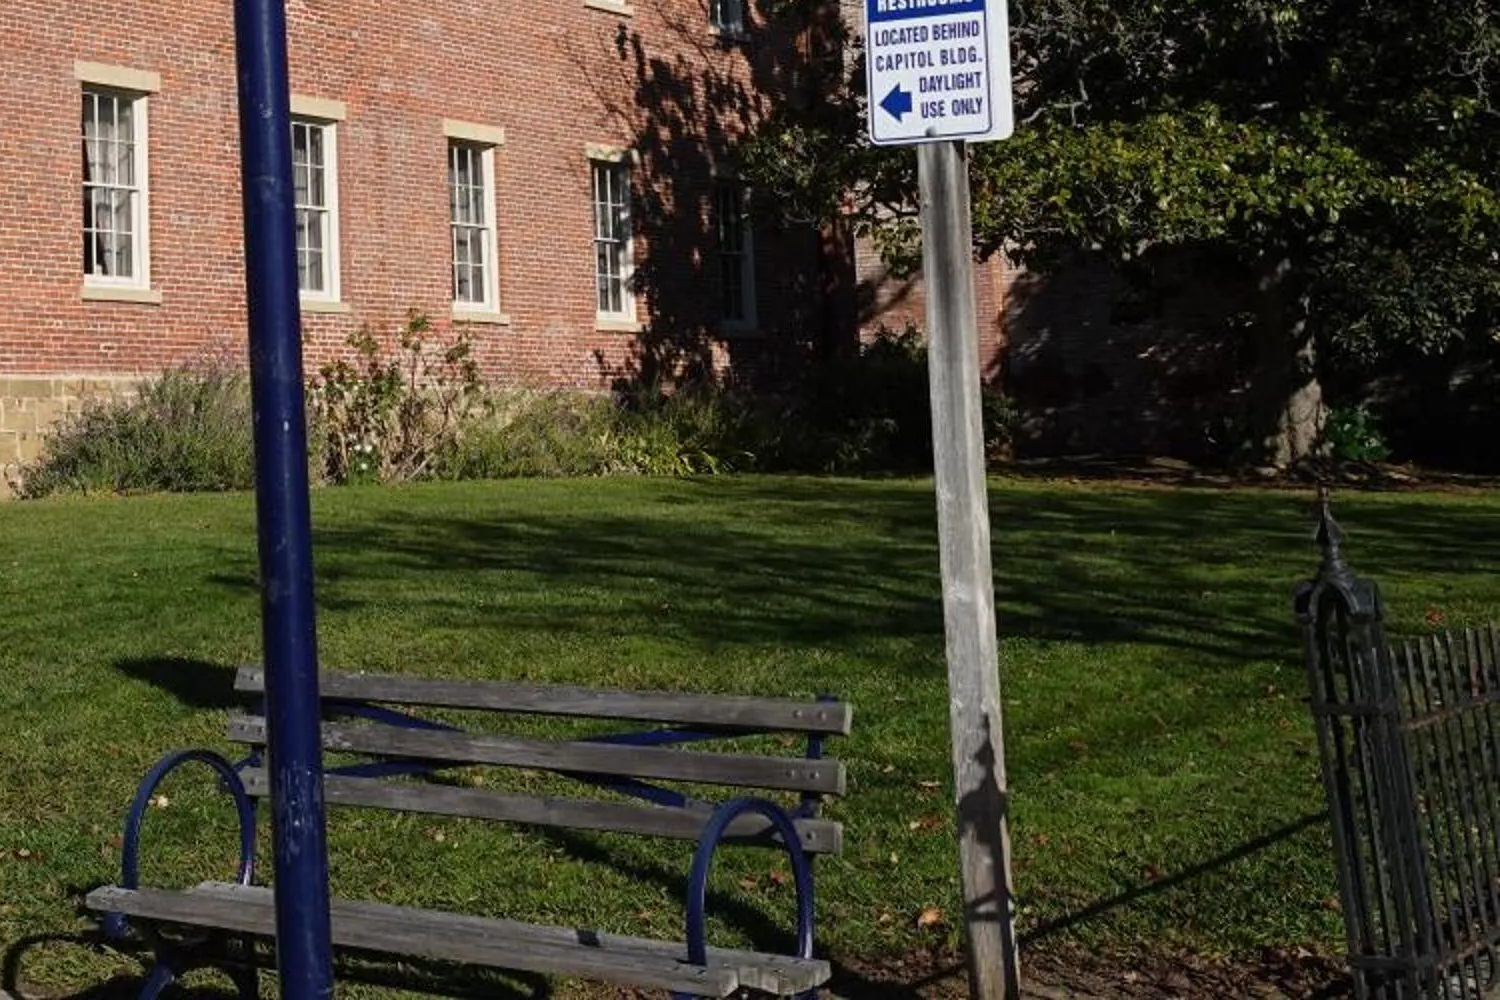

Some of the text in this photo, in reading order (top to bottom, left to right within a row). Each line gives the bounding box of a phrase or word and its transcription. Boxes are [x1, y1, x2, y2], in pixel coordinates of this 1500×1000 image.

[875, 19, 980, 47] LOCATED BEHIND
[875, 46, 983, 72] CAPITOL BLDG.
[919, 71, 982, 93] DAYLIGHT
[920, 97, 983, 118] USE ONLY
